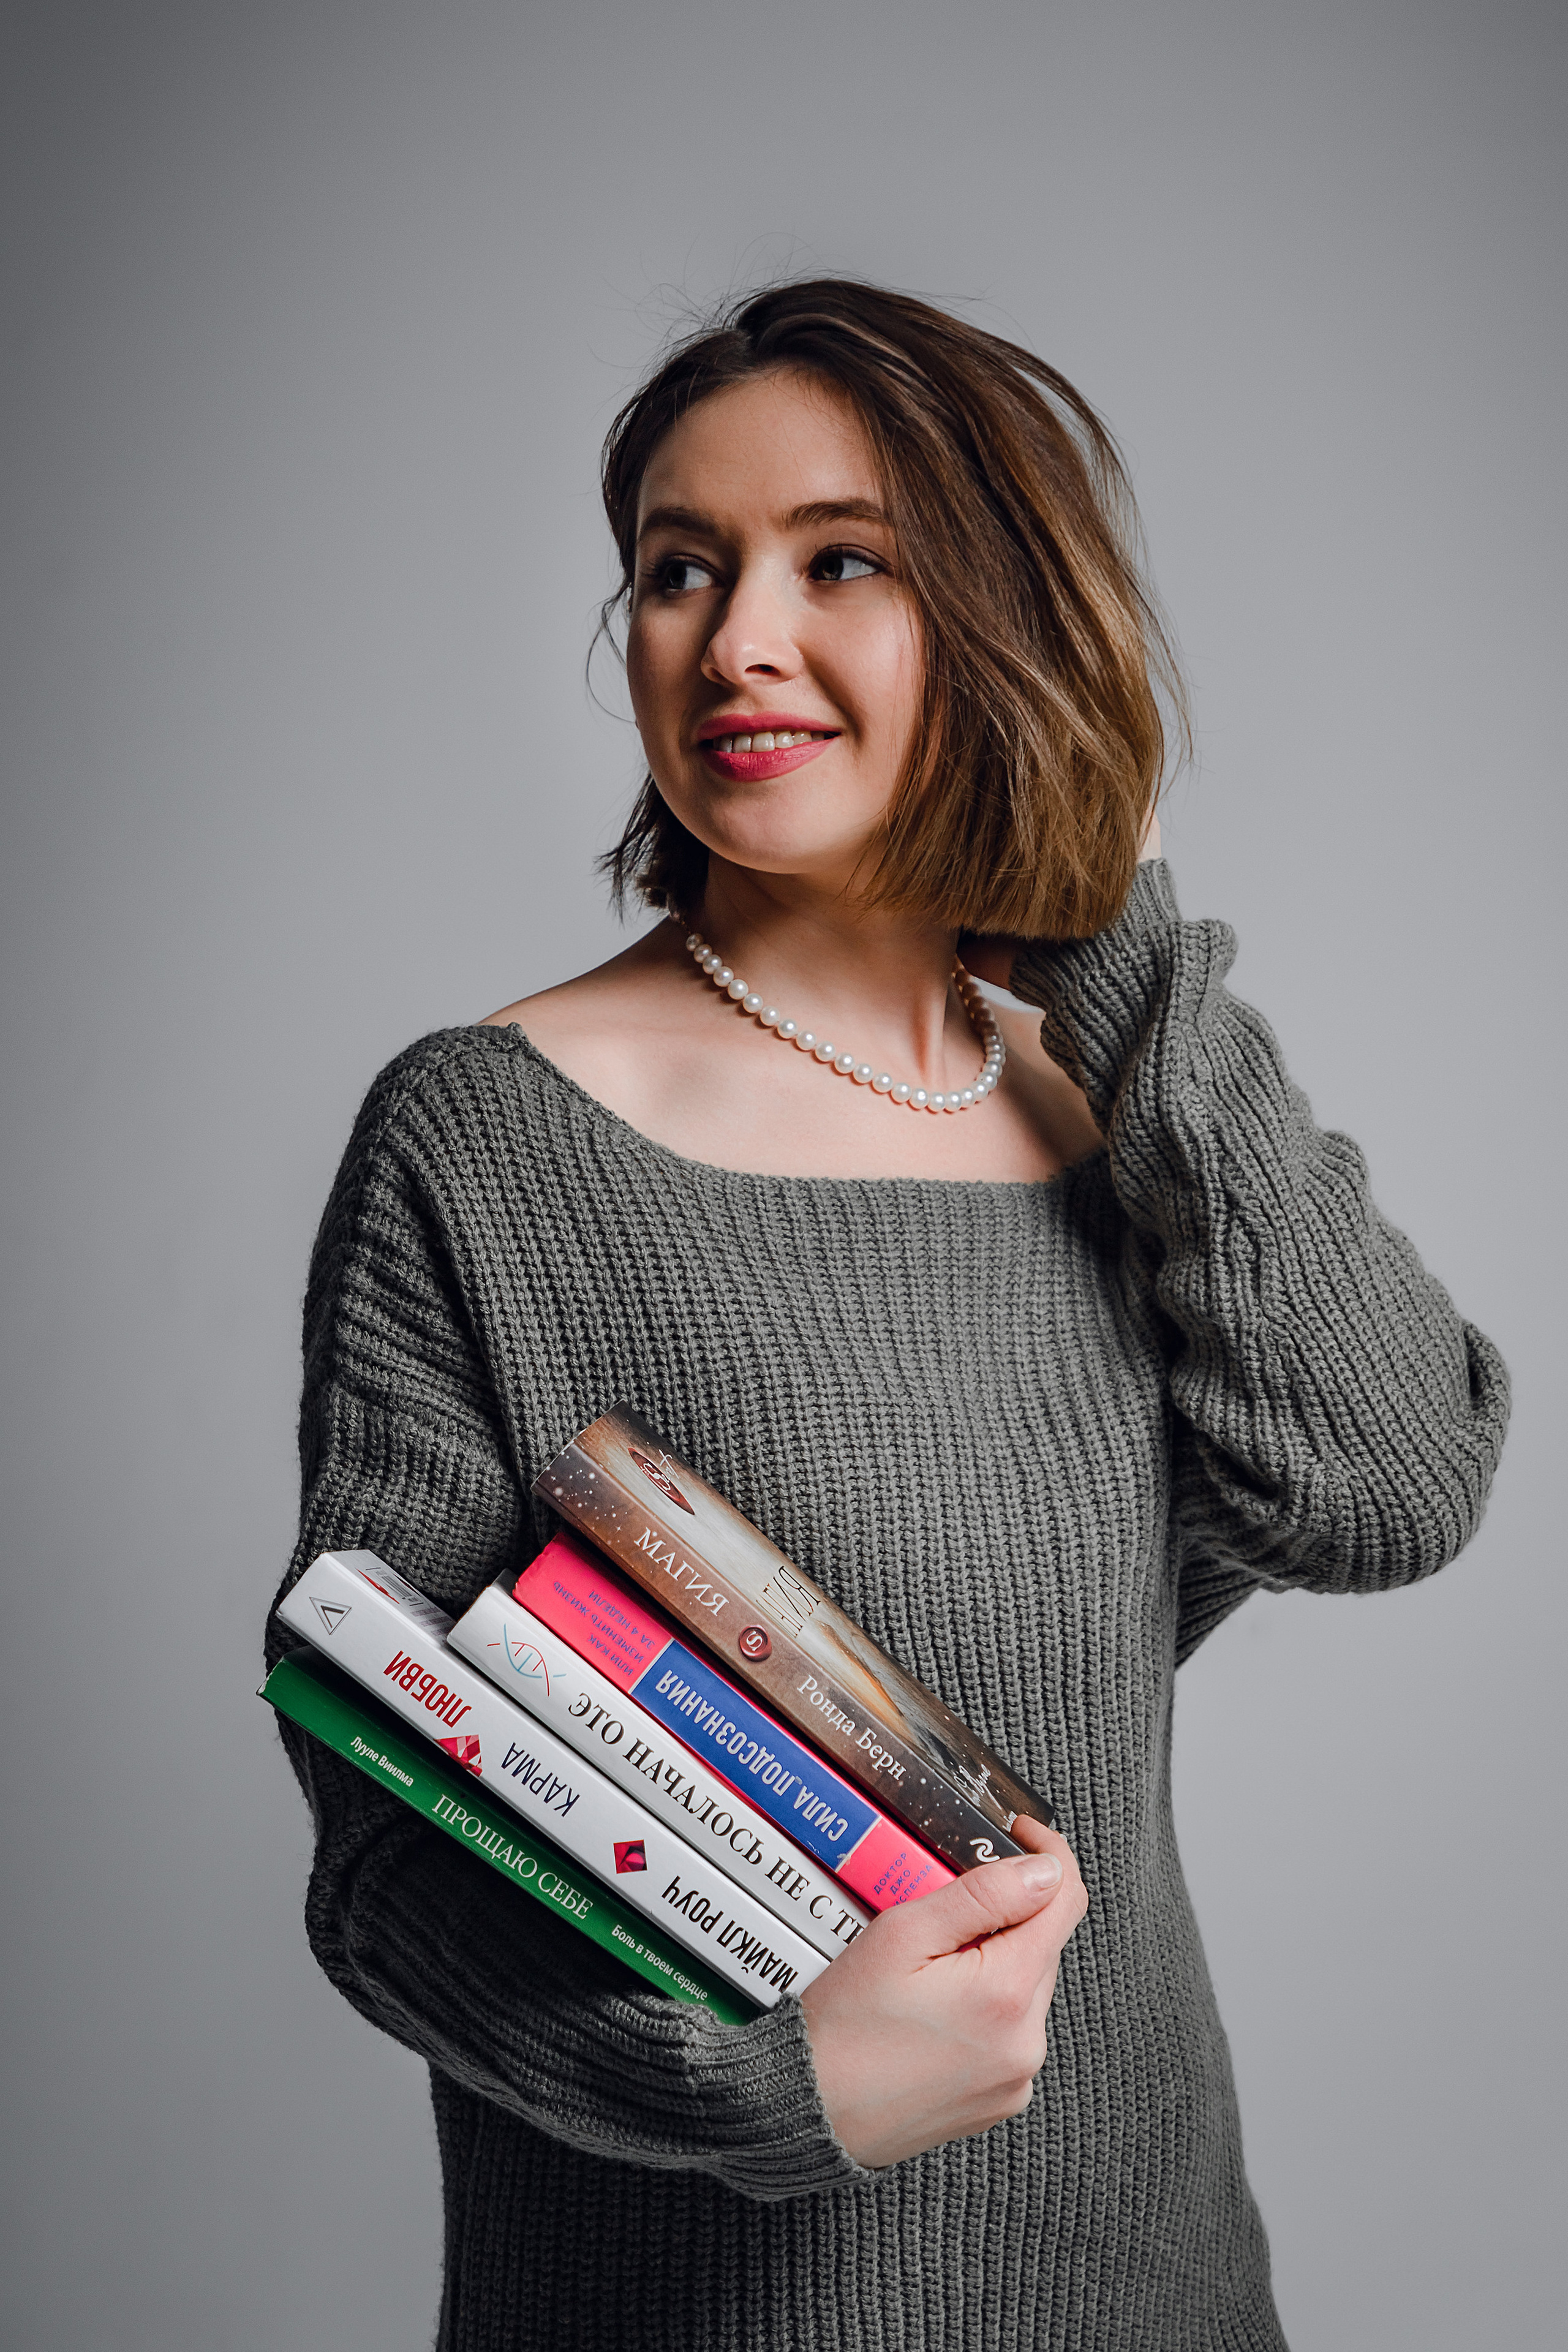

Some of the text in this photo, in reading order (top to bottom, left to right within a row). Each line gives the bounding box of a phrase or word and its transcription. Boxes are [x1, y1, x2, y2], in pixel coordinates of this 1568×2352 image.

[589, 1591, 631, 1629] НЕДЕЛИ
[633, 1526, 729, 1616] МАГИЯ
[554, 1581, 644, 1664] ИЗМЕНИТЬ ЖИЗНЬ
[588, 1634, 633, 1676] ИЛИ КАК
[641, 1634, 655, 1650] ЗА
[350, 1736, 414, 1787] Лууле Виилма
[383, 1649, 581, 1817] КАРМА ЛЮБВИ
[655, 1670, 796, 1796] ПОДСОЗНАНИЯ
[797, 1675, 907, 1780] Ронда Берн
[568, 1692, 624, 1745] ЭТО
[622, 1737, 764, 1865] НАЧАЛОСЬ
[764, 1856, 811, 1901] НЕ
[809, 1895, 833, 1919] С
[793, 1785, 849, 1842] СИЛА
[431, 1794, 594, 1920] ПРОЩАЮ СЕБЕ
[873, 1852, 907, 1894] ДОКТОР
[890, 1869, 911, 1894] ДЖО
[611, 1924, 708, 2001] Боль в твоем сердце
[661, 1875, 799, 1994] МАЙКЛ РОУЧ
